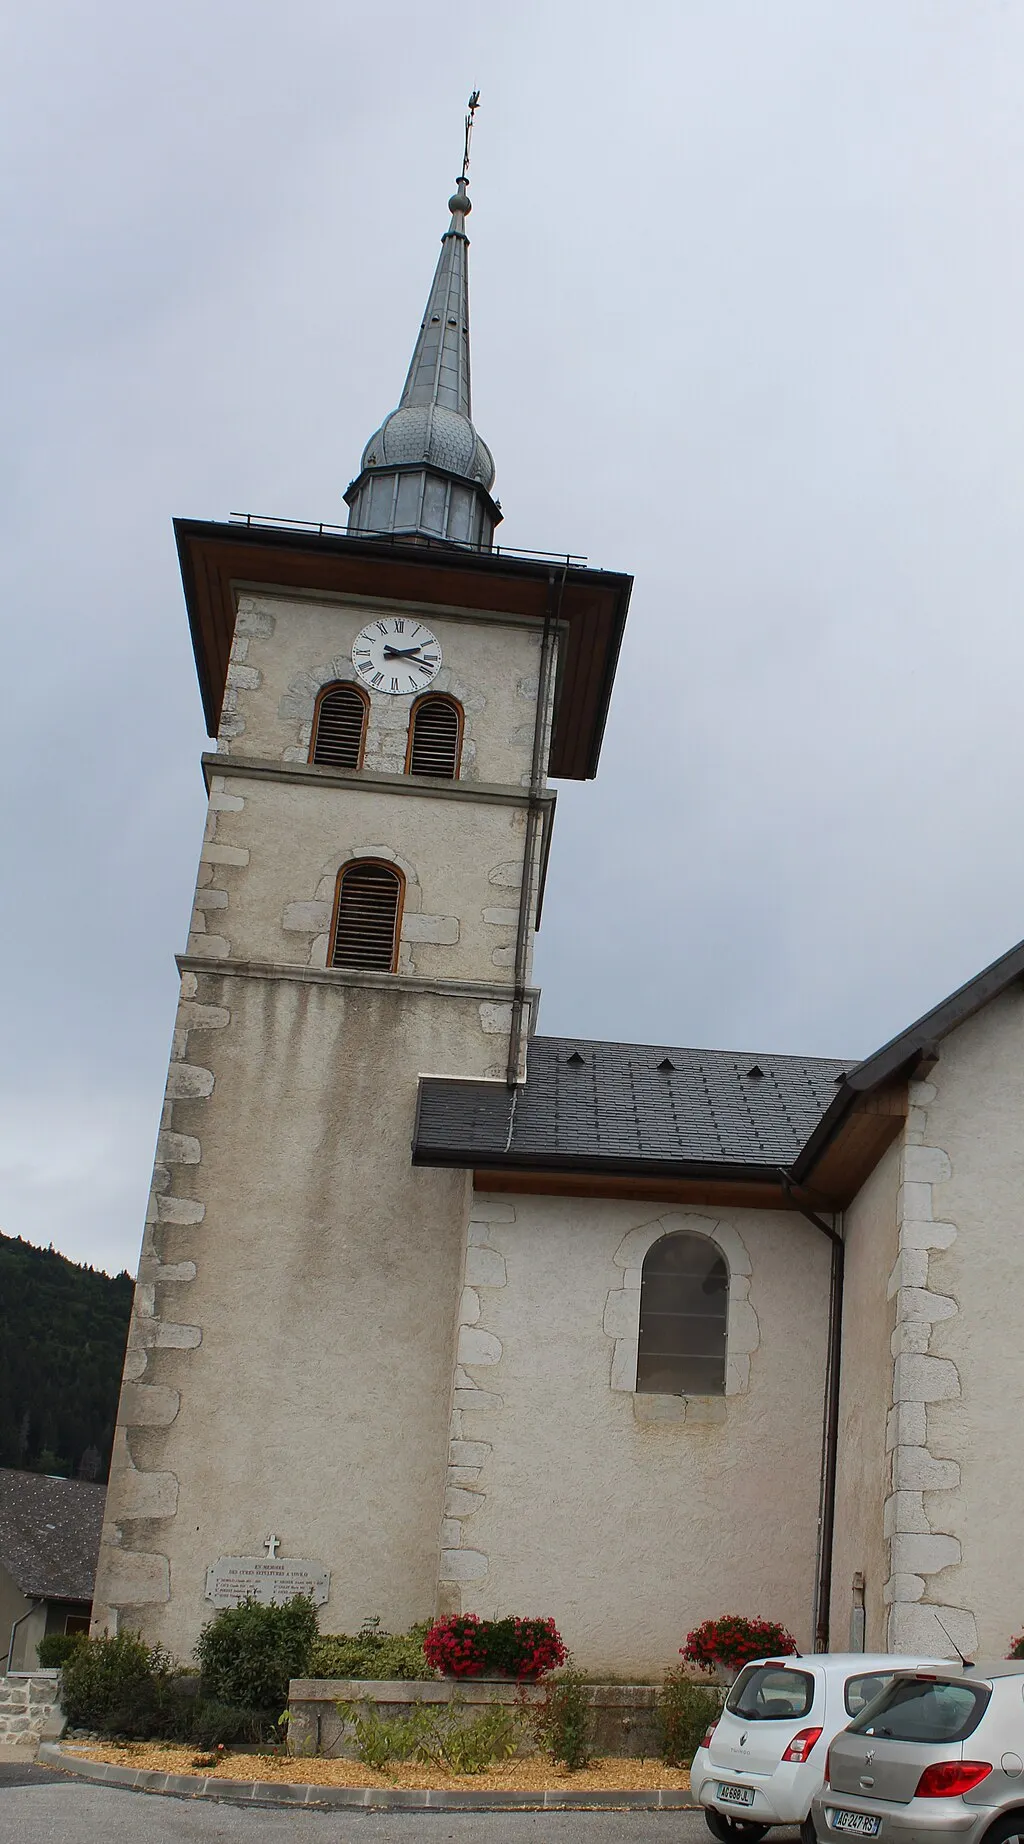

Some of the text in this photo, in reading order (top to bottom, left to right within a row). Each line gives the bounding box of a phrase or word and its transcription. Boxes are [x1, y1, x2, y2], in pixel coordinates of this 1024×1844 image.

[376, 622, 388, 636] XI
[394, 621, 405, 633] XII
[362, 633, 376, 644] X
[356, 648, 370, 656] IX
[371, 672, 384, 686] VII
[408, 675, 418, 688] V
